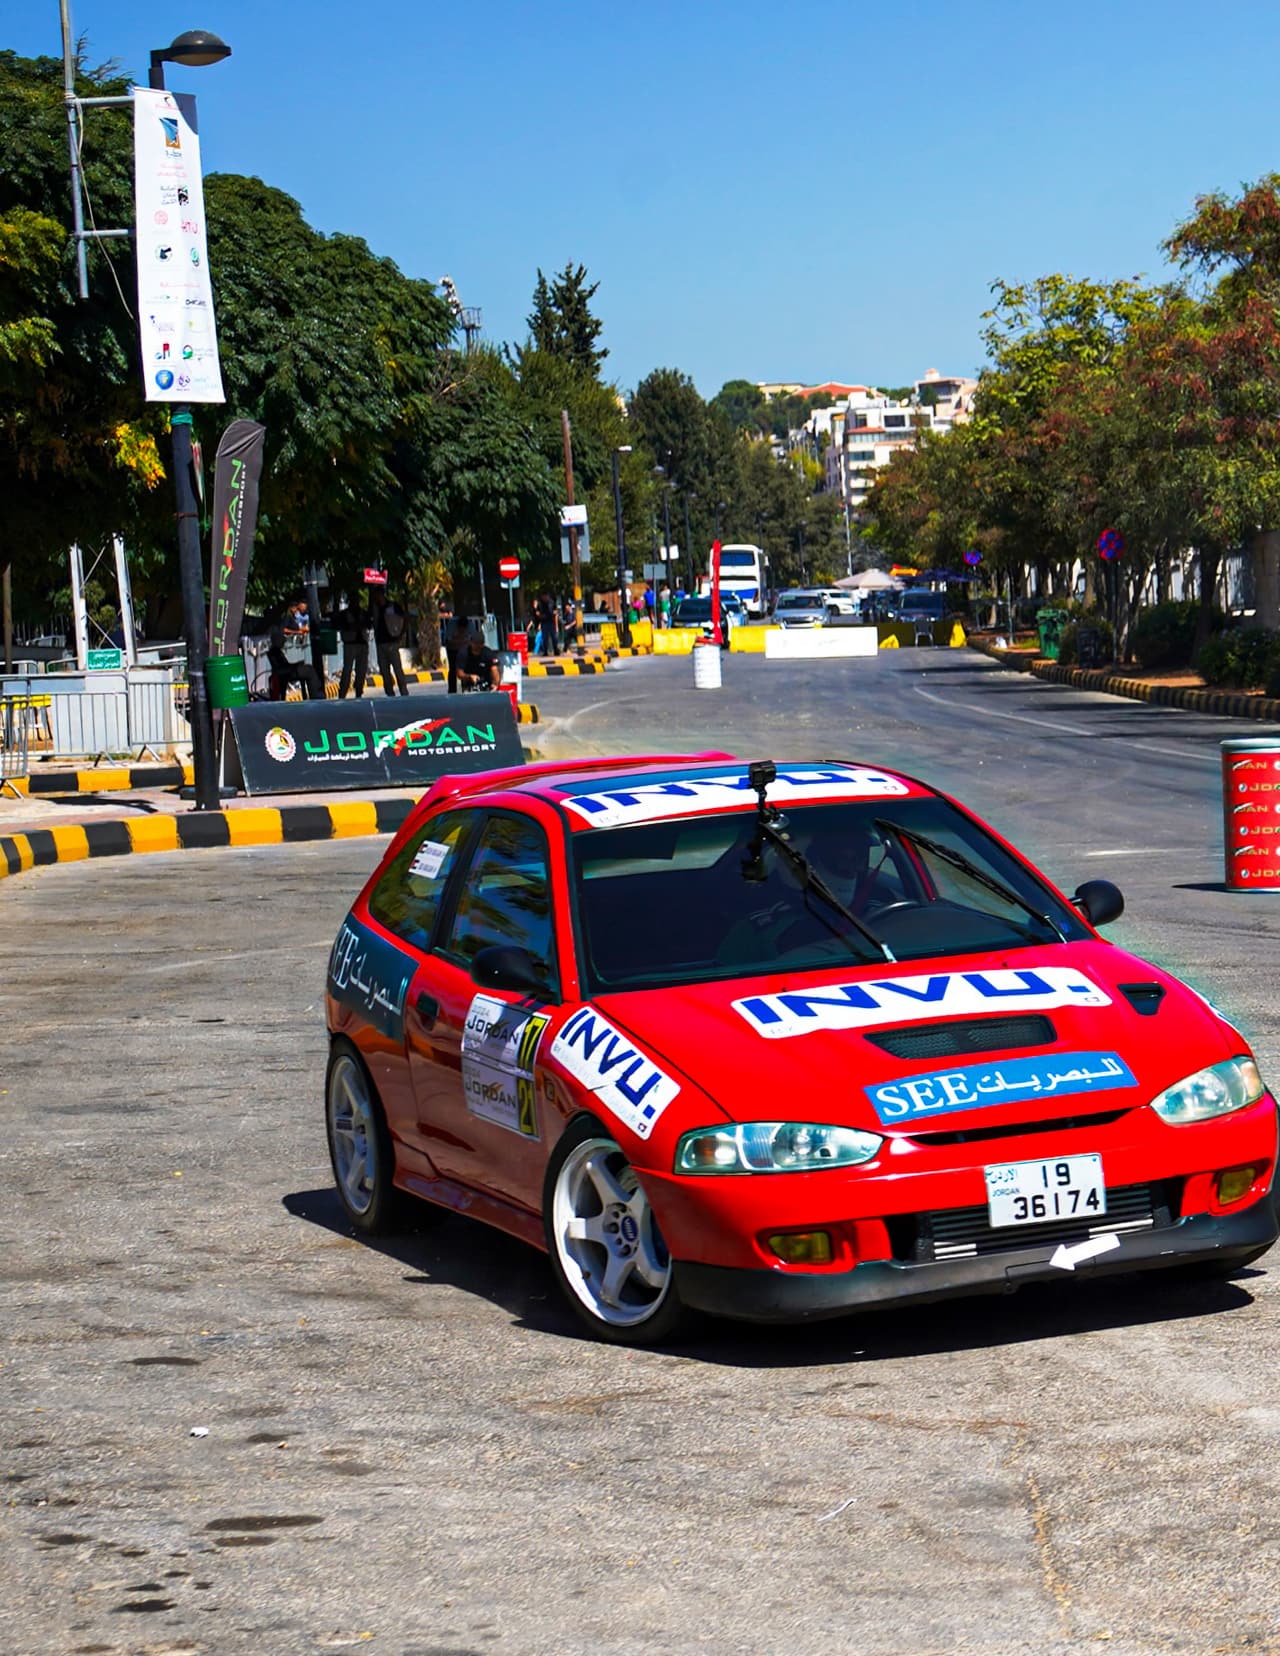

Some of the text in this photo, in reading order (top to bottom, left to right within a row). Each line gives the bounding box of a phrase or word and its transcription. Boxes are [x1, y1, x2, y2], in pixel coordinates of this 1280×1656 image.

[304, 723, 496, 753] JORDAN
[408, 743, 497, 756] MOTORSPORT
[467, 1015, 519, 1044] JORDAN
[521, 1017, 547, 1070] 17
[465, 1081, 516, 1109] JORDAN
[519, 1079, 538, 1136] 21
[876, 1073, 978, 1117] SEE
[1042, 1163, 1071, 1188] 19
[1013, 1188, 1100, 1220] 36174
